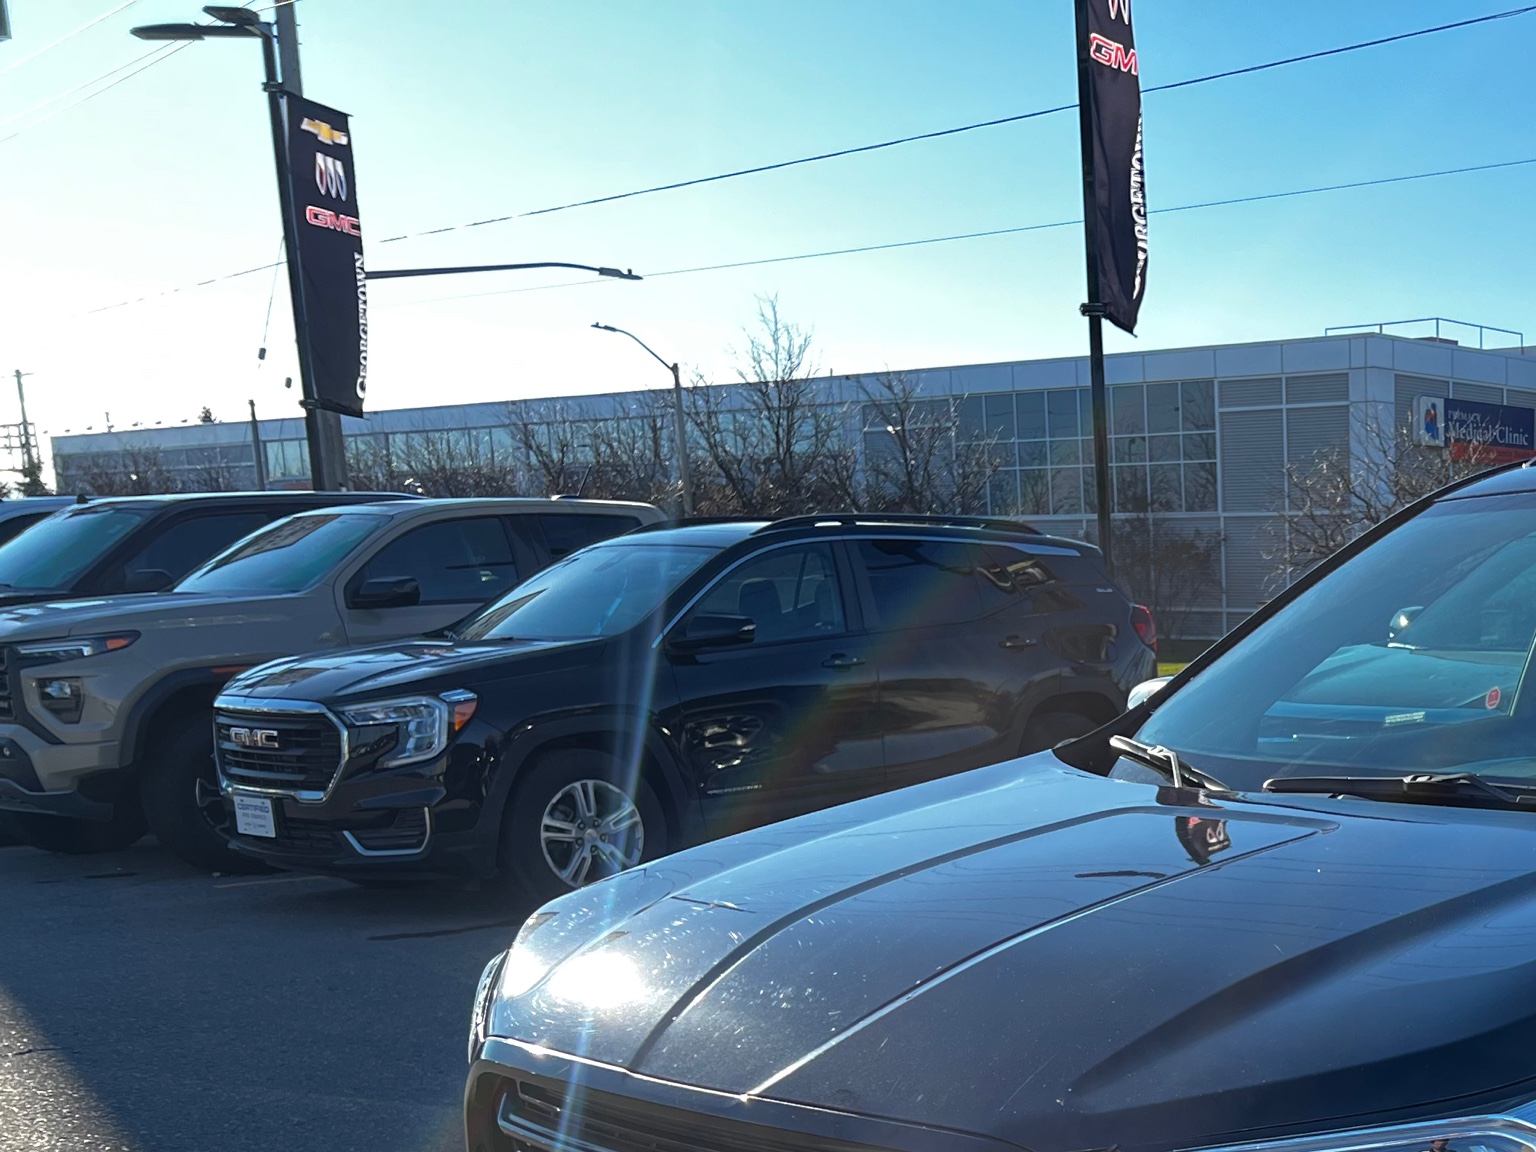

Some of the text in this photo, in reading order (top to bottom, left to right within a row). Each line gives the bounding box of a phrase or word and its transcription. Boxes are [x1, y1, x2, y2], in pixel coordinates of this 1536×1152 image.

[1089, 32, 1139, 76] GM
[306, 205, 361, 236] GMC
[1448, 420, 1529, 446] Medical Clinic
[230, 727, 279, 748] GMC
